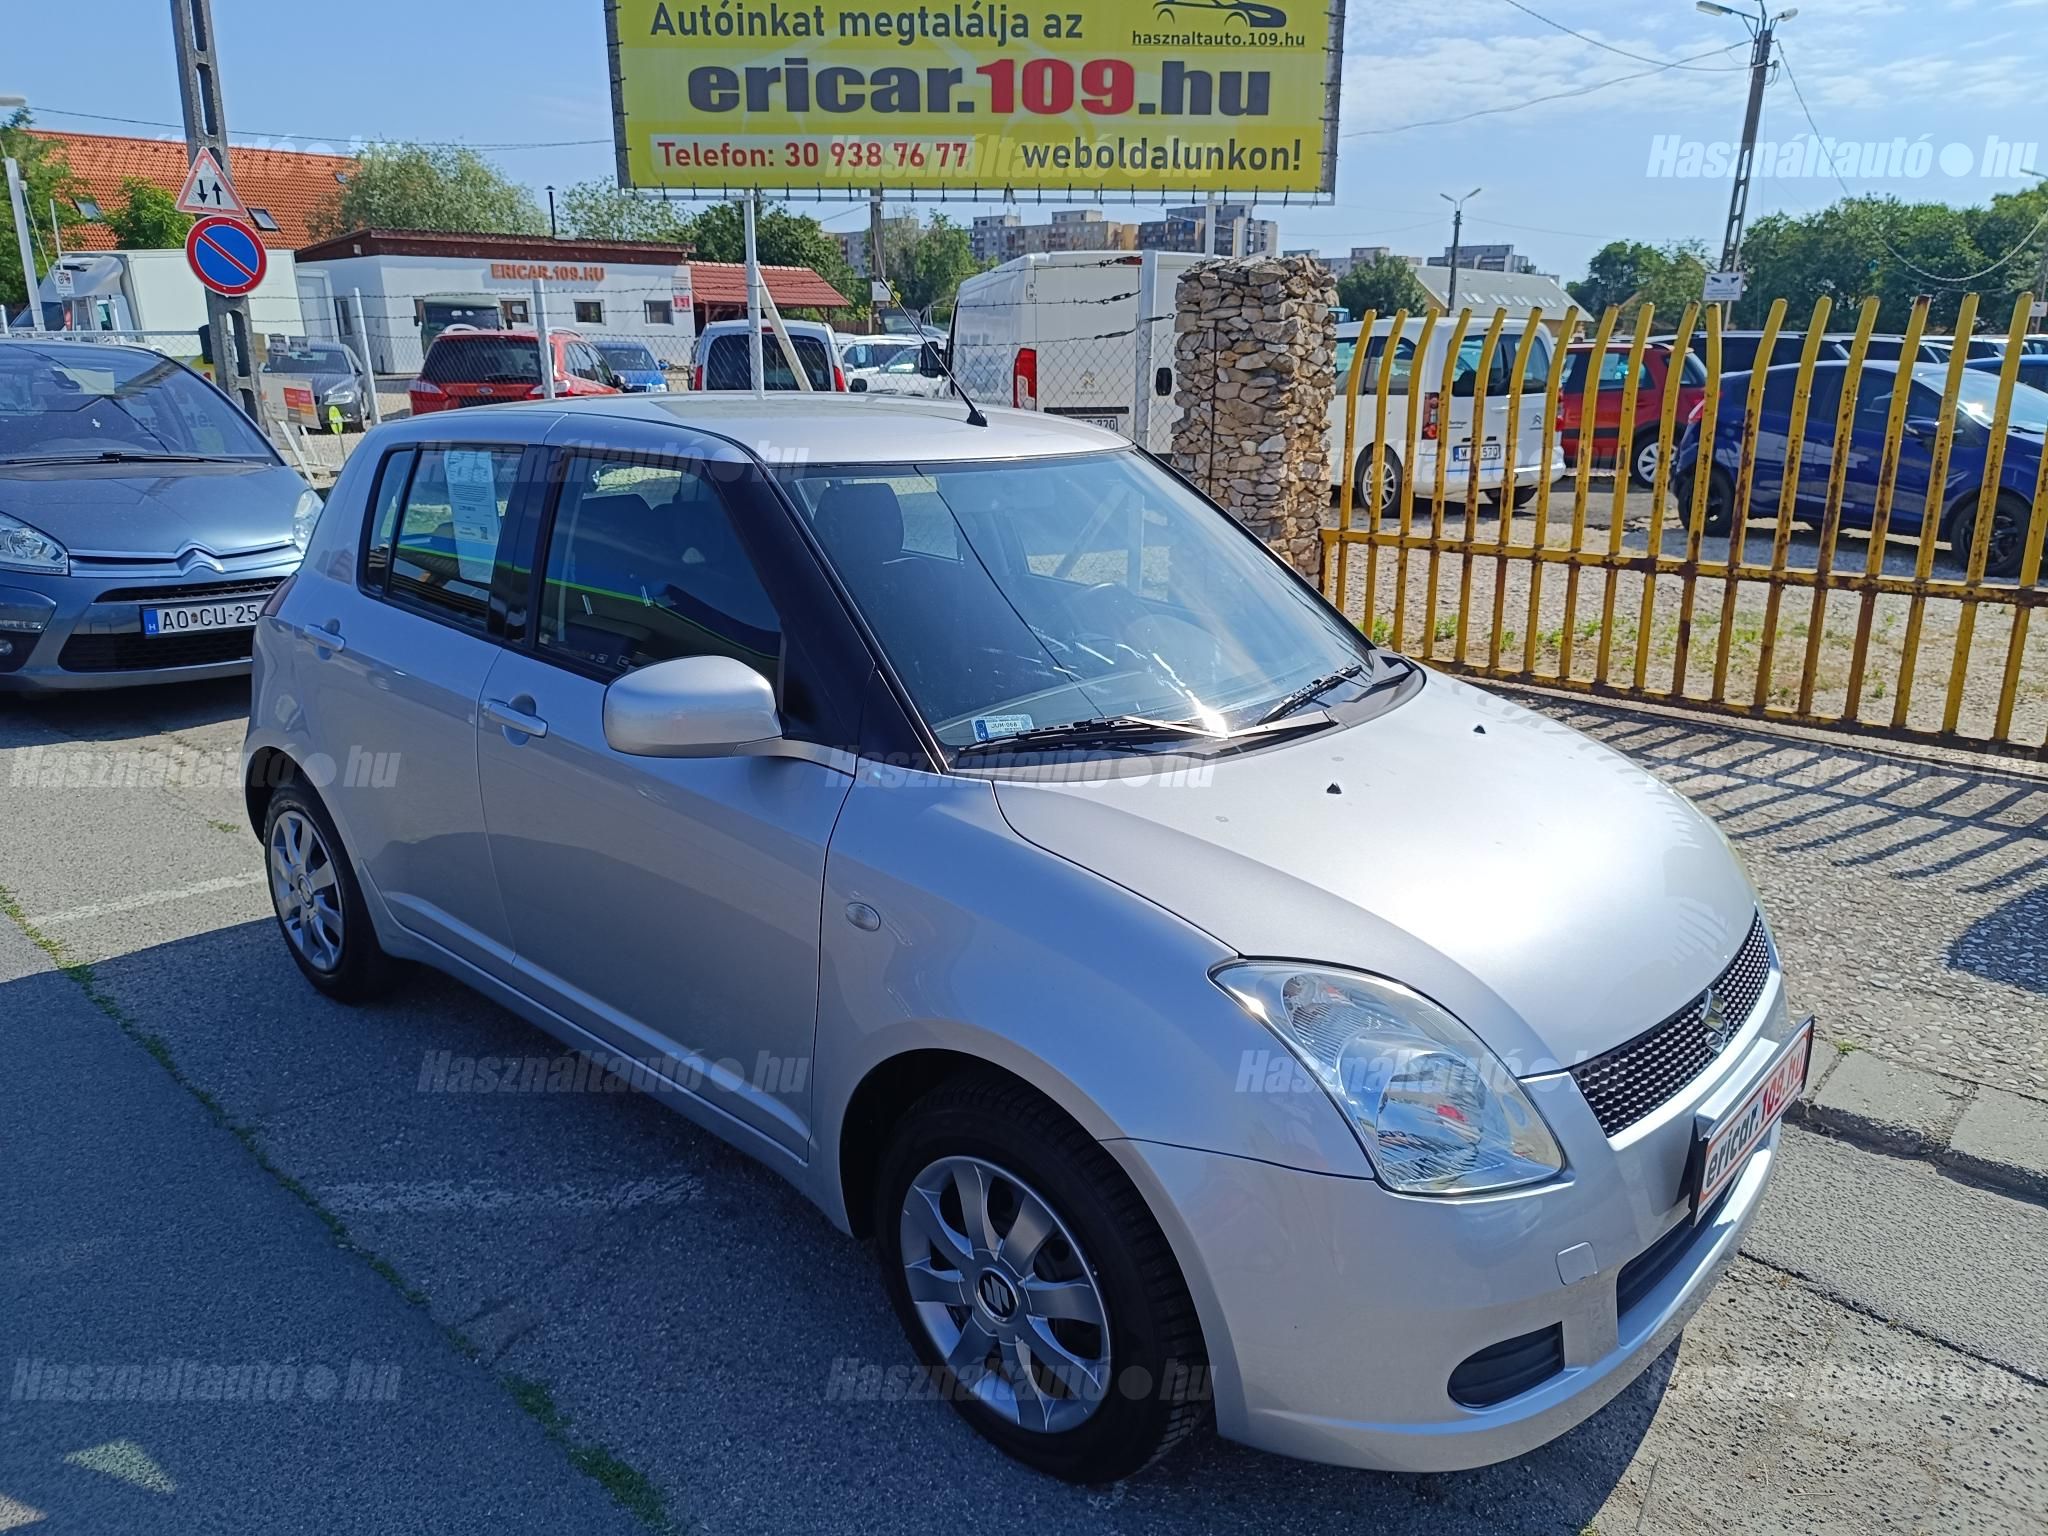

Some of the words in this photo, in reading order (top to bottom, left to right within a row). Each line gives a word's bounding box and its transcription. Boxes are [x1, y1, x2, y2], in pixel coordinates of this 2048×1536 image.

[650, 1, 825, 37] Autóinkat
[839, 1, 1029, 47] megtalálja
[1043, 13, 1083, 39] az
[1132, 30, 1306, 47] hasznaltauto.109.hu
[687, 57, 1270, 117] ericar.109.hu
[657, 142, 775, 167] Telefon:
[785, 142, 819, 167] 30
[830, 142, 882, 167] 938
[893, 142, 925, 167] 76
[936, 142, 968, 167] 77
[1021, 137, 1301, 171] weboldalunkon!
[490, 263, 605, 281] ERICAR.109.HU
